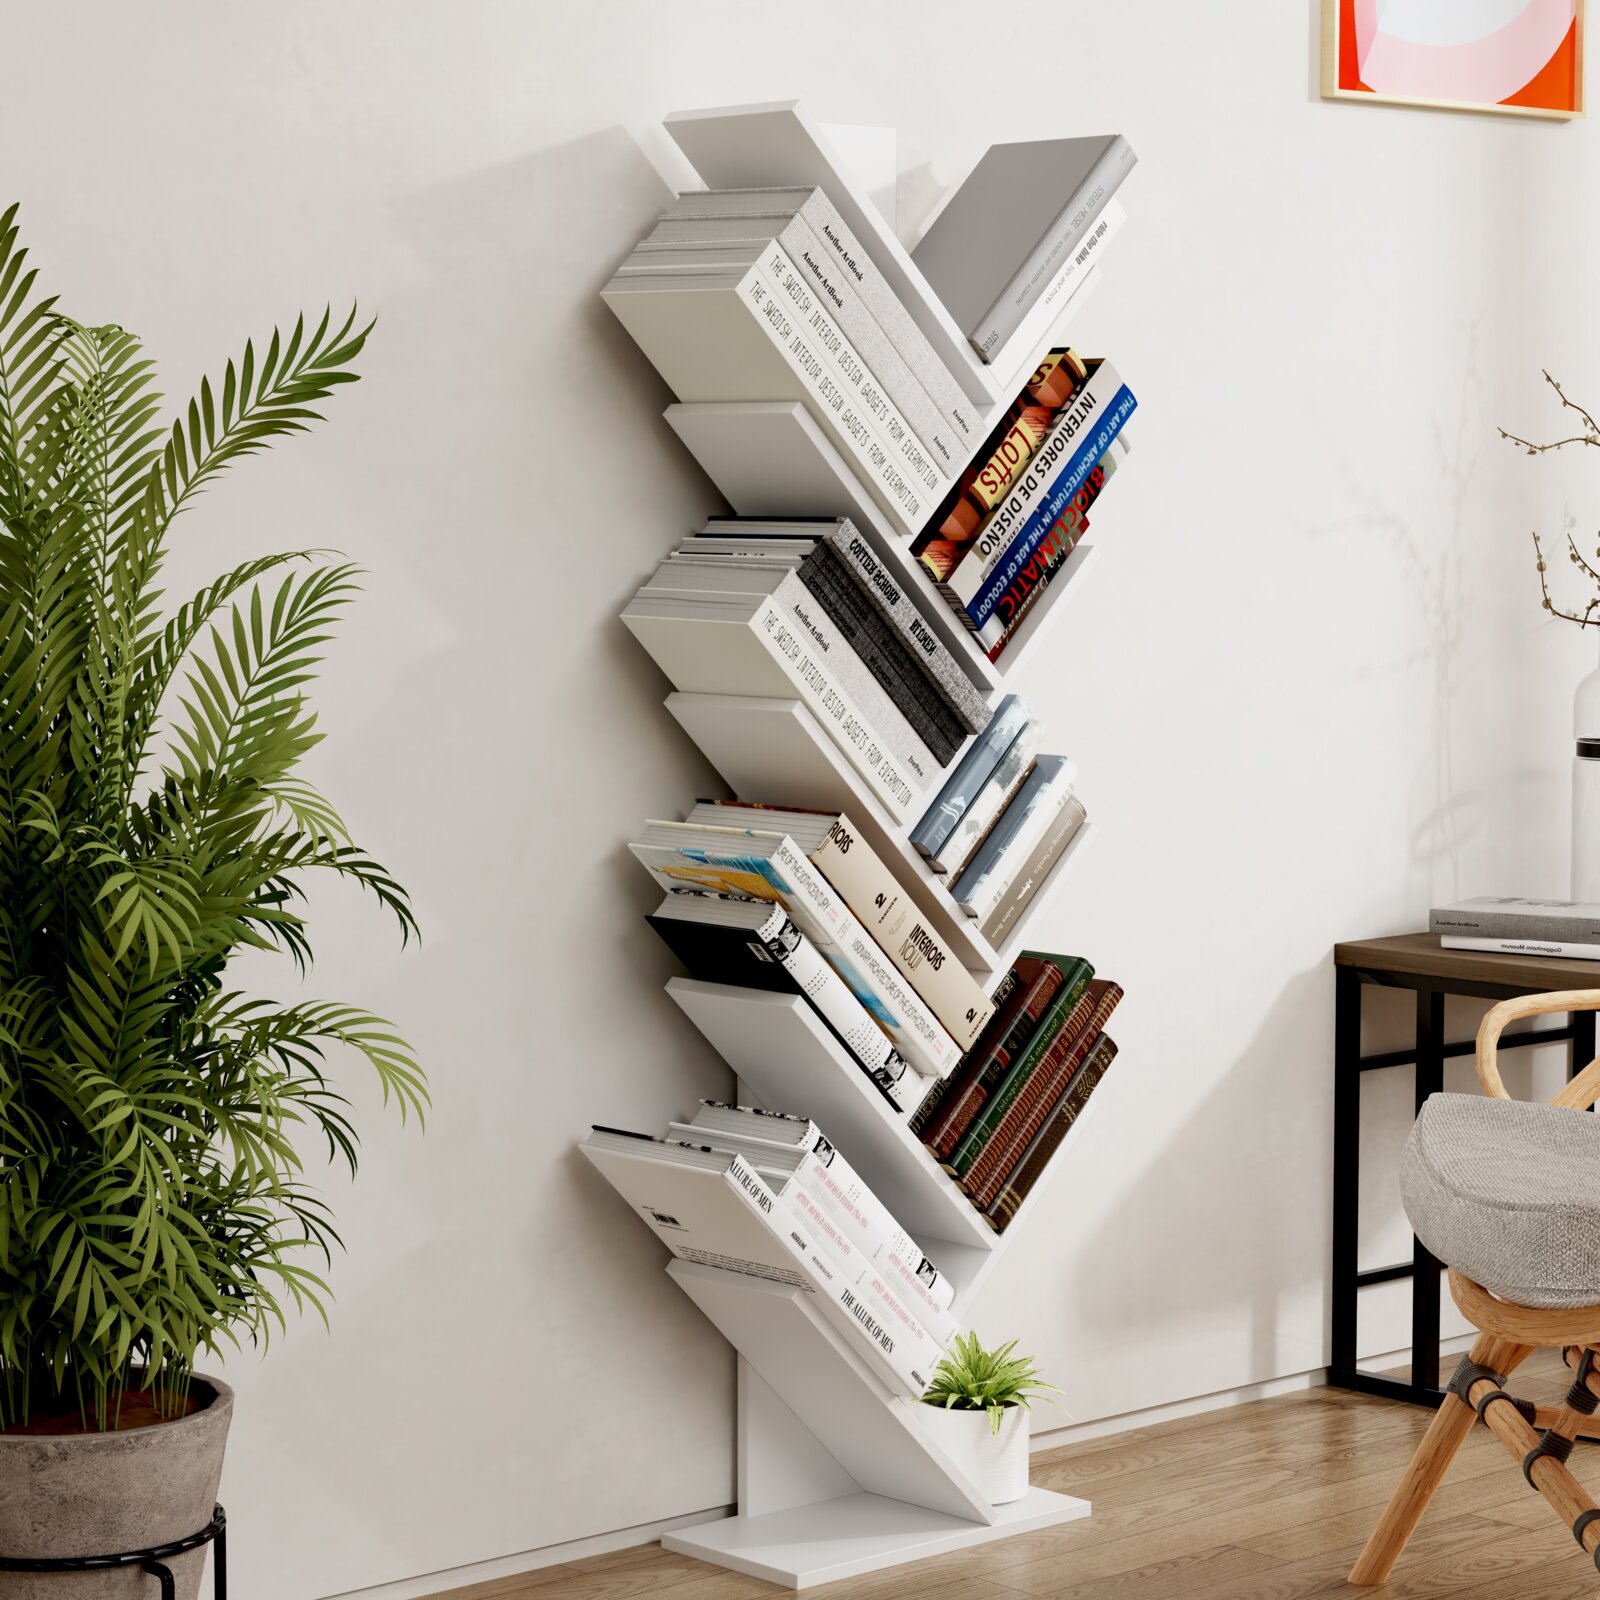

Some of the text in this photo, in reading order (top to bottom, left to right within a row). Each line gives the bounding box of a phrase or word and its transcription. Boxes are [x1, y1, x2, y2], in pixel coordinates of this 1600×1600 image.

[1085, 233, 1098, 252] the
[1094, 219, 1108, 240] ride
[821, 222, 864, 283] Another ArtBook
[1074, 246, 1090, 267] bike
[800, 249, 844, 310] Another ArtBook
[768, 253, 939, 493] THE SWEDISH INTERIOR DESIGN GADGETS FROM EVERMOTION
[748, 279, 921, 518] THE SWEDISH INTERIOR DESIGN GADGETS FROM EVERMOTION
[1032, 389, 1097, 480] INTERIORES
[1017, 472, 1039, 502] DE
[974, 393, 1134, 622] THE ART OF ARCHITECTURE IN THE AGE OF ECOLOGY
[977, 495, 1024, 560] DISEÑO
[993, 464, 1108, 618] BIOCLIMATIC
[1005, 524, 1019, 544] CASA
[988, 541, 1008, 568] ACTUAL
[791, 602, 831, 653] Another ArtBook
[760, 609, 914, 810] THE SWEDISH INTERIOR DESIGN GADGETS FROM EVERMOTION
[873, 890, 887, 909] 2
[897, 937, 924, 972] NOW!
[907, 922, 946, 972] INTERIORS
[866, 956, 898, 996] ARCHITECTURE
[964, 1005, 977, 1024] 2
[726, 1158, 775, 1215] ALLURE OF MEN
[838, 1287, 858, 1310] THE
[849, 1300, 878, 1333] ALLURE
[869, 1323, 885, 1341] OF
[876, 1332, 897, 1355] MEN
